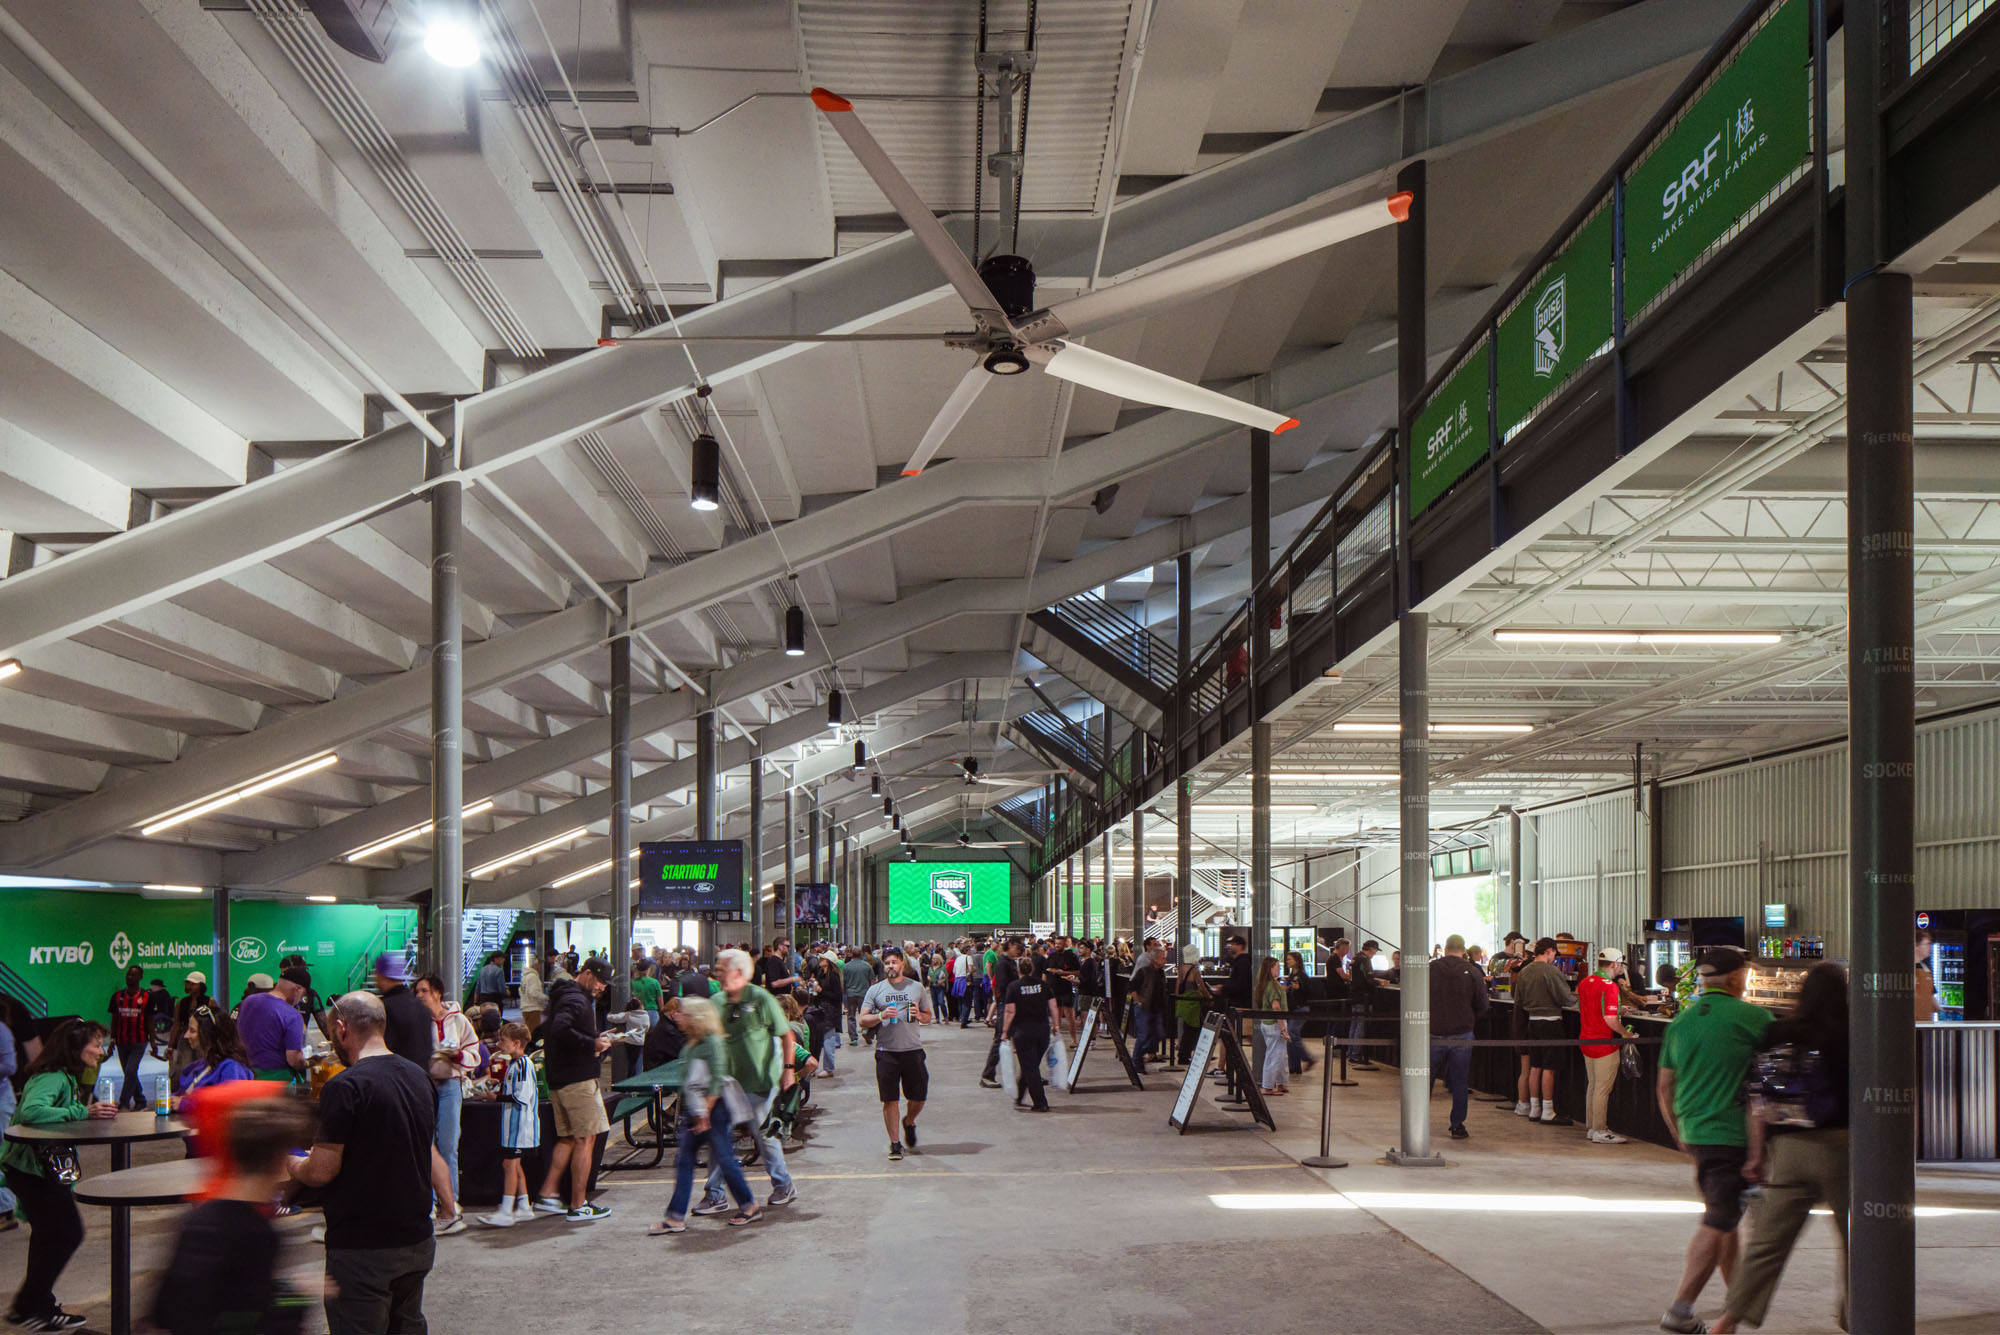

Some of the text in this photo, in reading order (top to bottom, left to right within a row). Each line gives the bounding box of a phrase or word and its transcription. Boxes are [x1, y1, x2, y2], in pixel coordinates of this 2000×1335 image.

[1663, 131, 1721, 220] SRF
[1651, 133, 1765, 253] SNAKE RIVER FARMS
[1538, 292, 1561, 330] BOISE
[1427, 415, 1454, 460] SRF
[1863, 761, 1914, 779] SOCKE
[661, 864, 718, 880] STARTING XI
[936, 879, 966, 889] BOISE
[137, 941, 214, 960] Saint Alphonsu
[236, 940, 260, 959] Ford
[885, 994, 909, 1002] BOISE
[1020, 984, 1042, 995] STAFF
